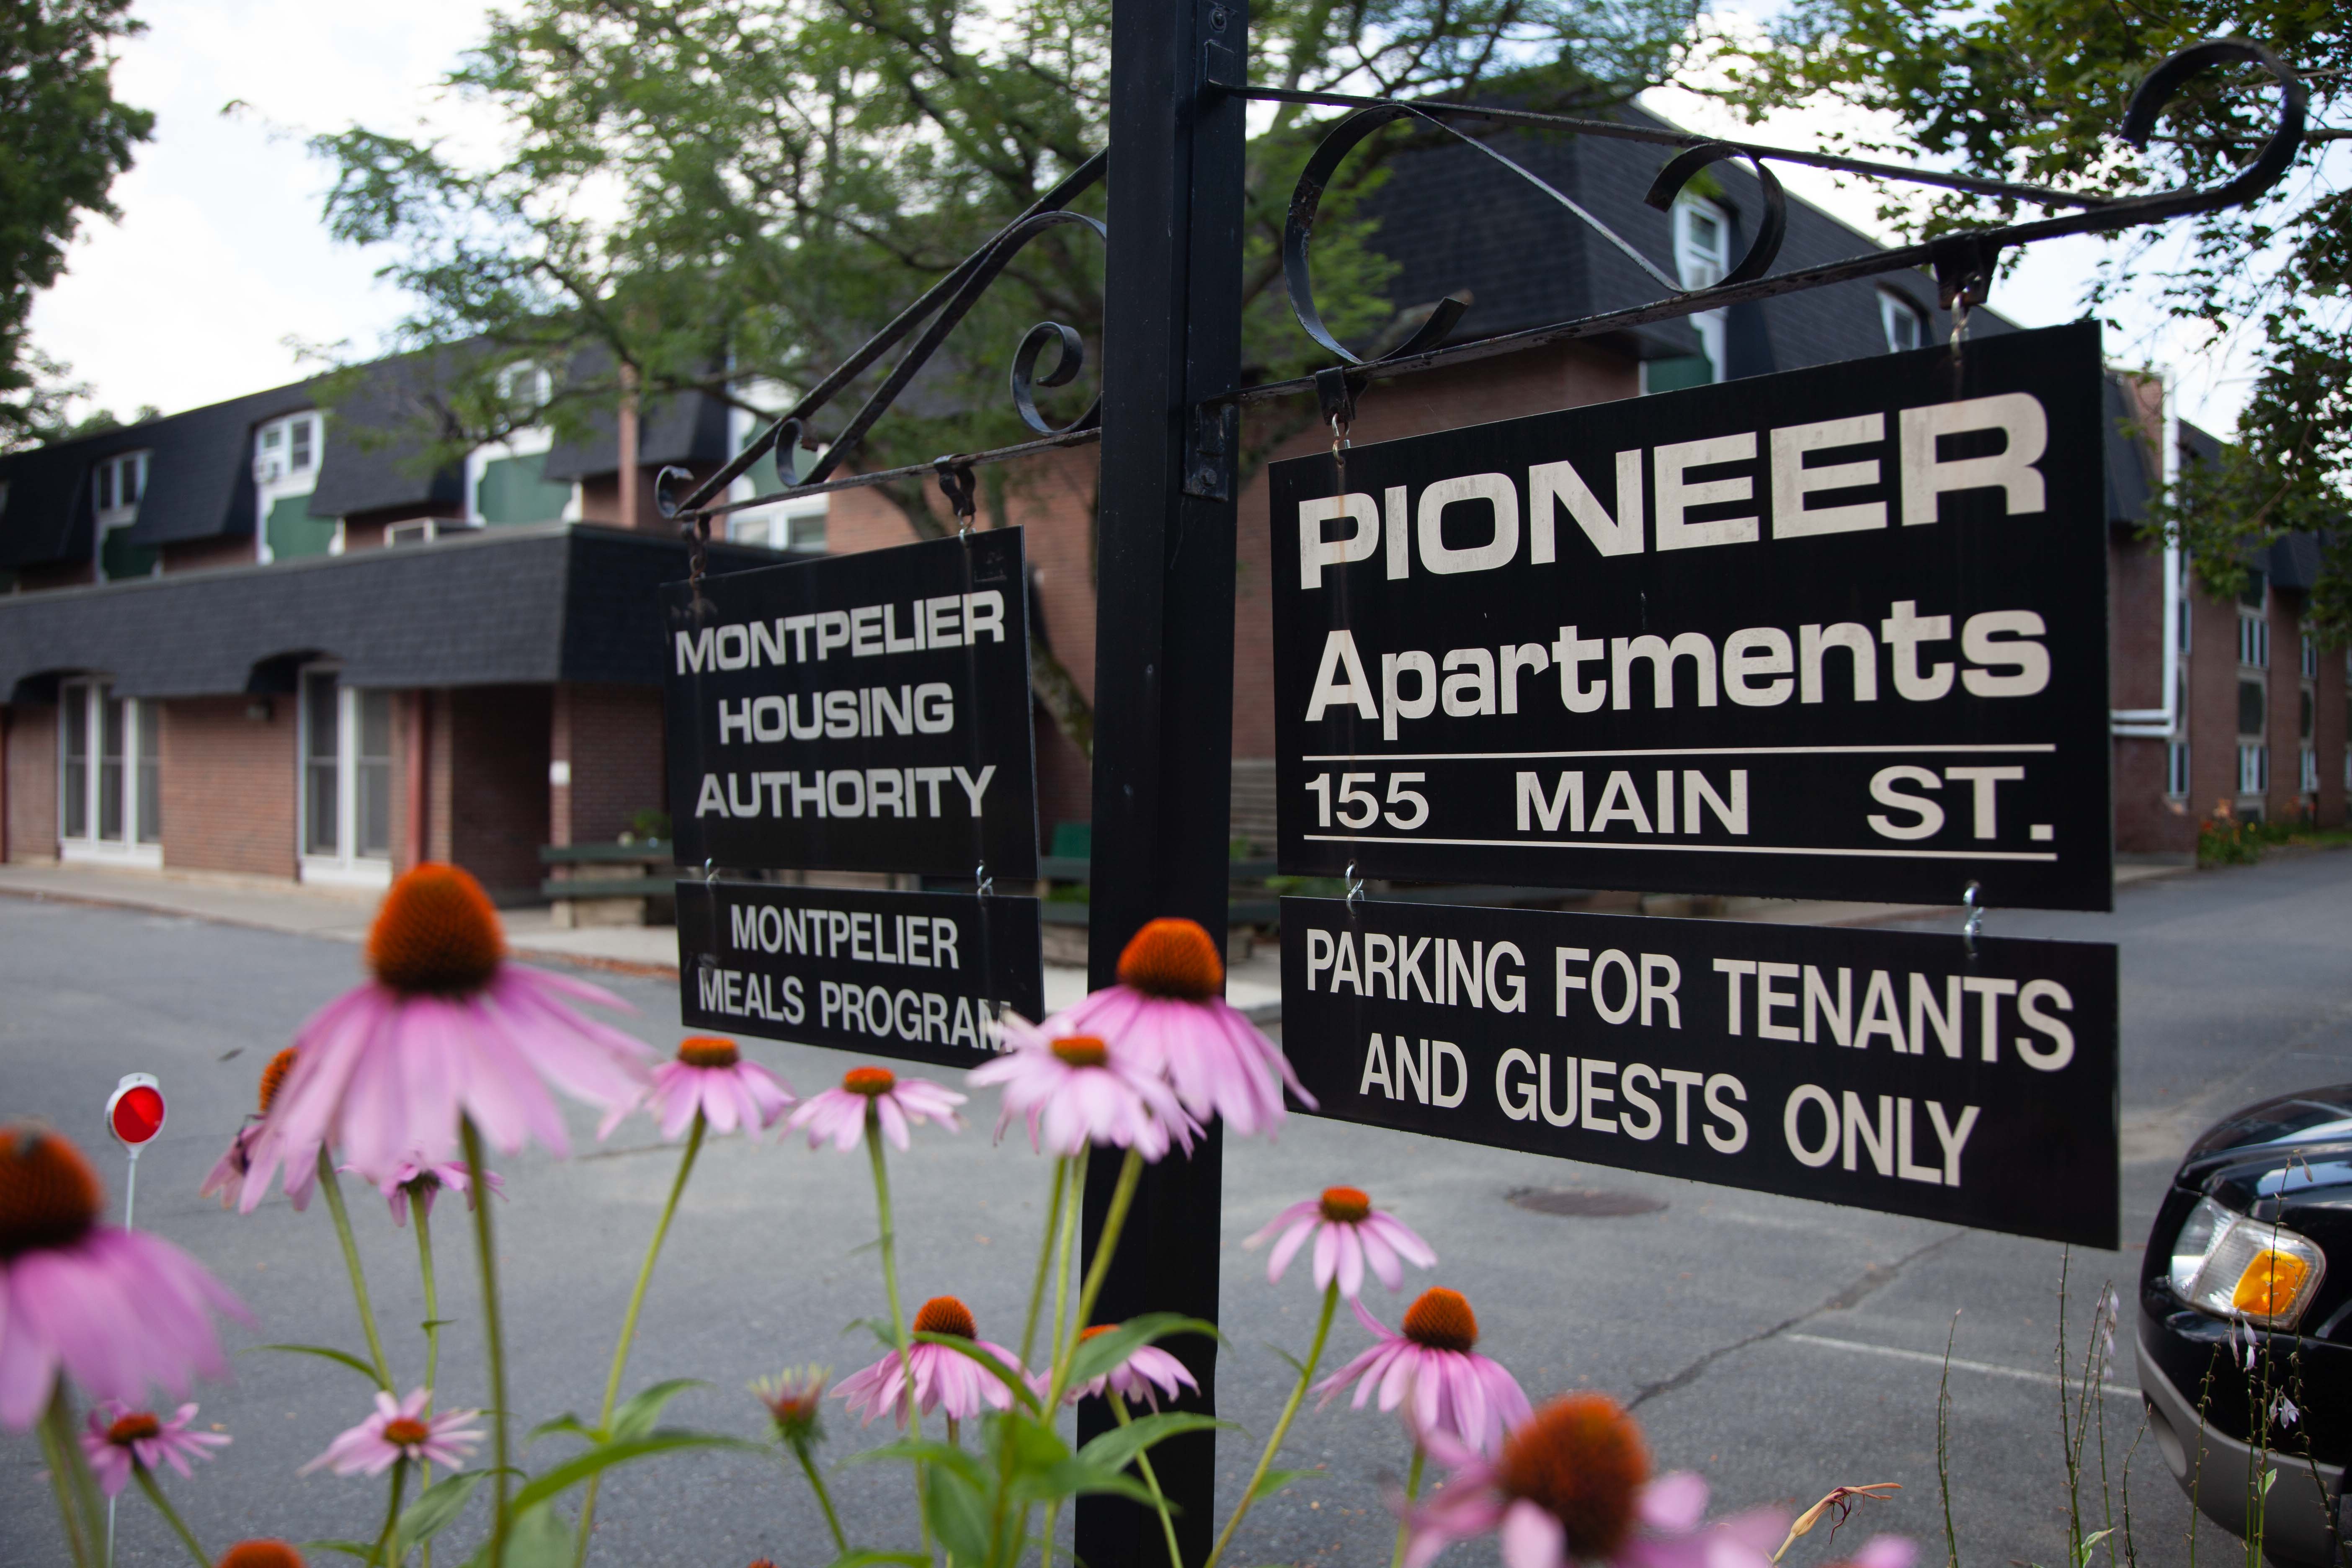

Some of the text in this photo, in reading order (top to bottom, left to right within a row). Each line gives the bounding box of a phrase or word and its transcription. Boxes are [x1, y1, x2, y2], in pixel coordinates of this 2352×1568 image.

[1299, 392, 2048, 589] PIONEER
[676, 590, 1004, 674] MONTPELIER
[1305, 600, 2049, 740] Apartments
[718, 682, 953, 745] HOUSING
[696, 766, 996, 818] AUTHORITY
[1305, 766, 2053, 841] 155 MAIN ST.
[731, 905, 958, 970] MONTPELIER
[699, 967, 1013, 1053] MEALS PROGRAM
[1306, 929, 2073, 1072] PARKING FOR TENANTS
[1360, 1033, 1980, 1187] AND GUESTS ONLY
